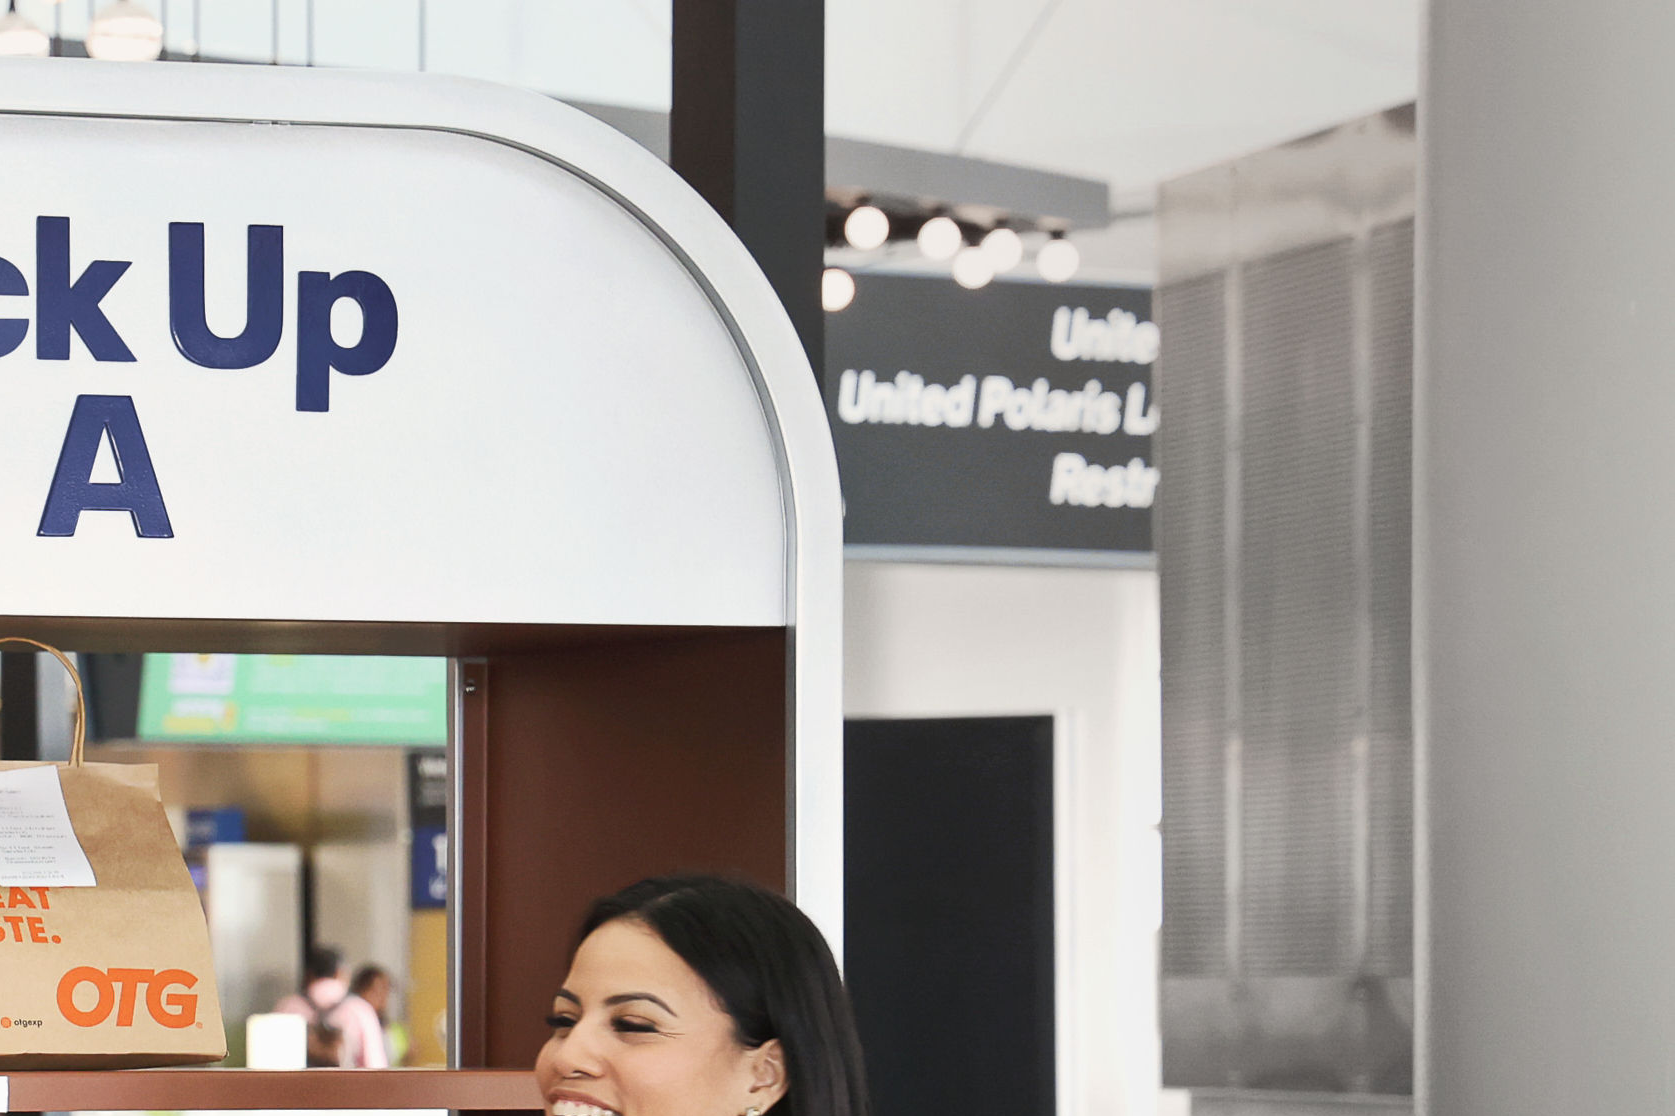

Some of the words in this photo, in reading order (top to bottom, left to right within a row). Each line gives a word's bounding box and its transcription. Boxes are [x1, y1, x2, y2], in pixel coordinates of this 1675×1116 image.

[168, 220, 399, 413] Up
[1050, 306, 1160, 364] Unite
[838, 368, 976, 428] United
[977, 375, 1121, 435] Polaris
[36, 393, 175, 538] A
[1049, 452, 1161, 508] Restr
[14, 1018, 43, 1028] otgexp
[56, 965, 199, 1028] OTG
